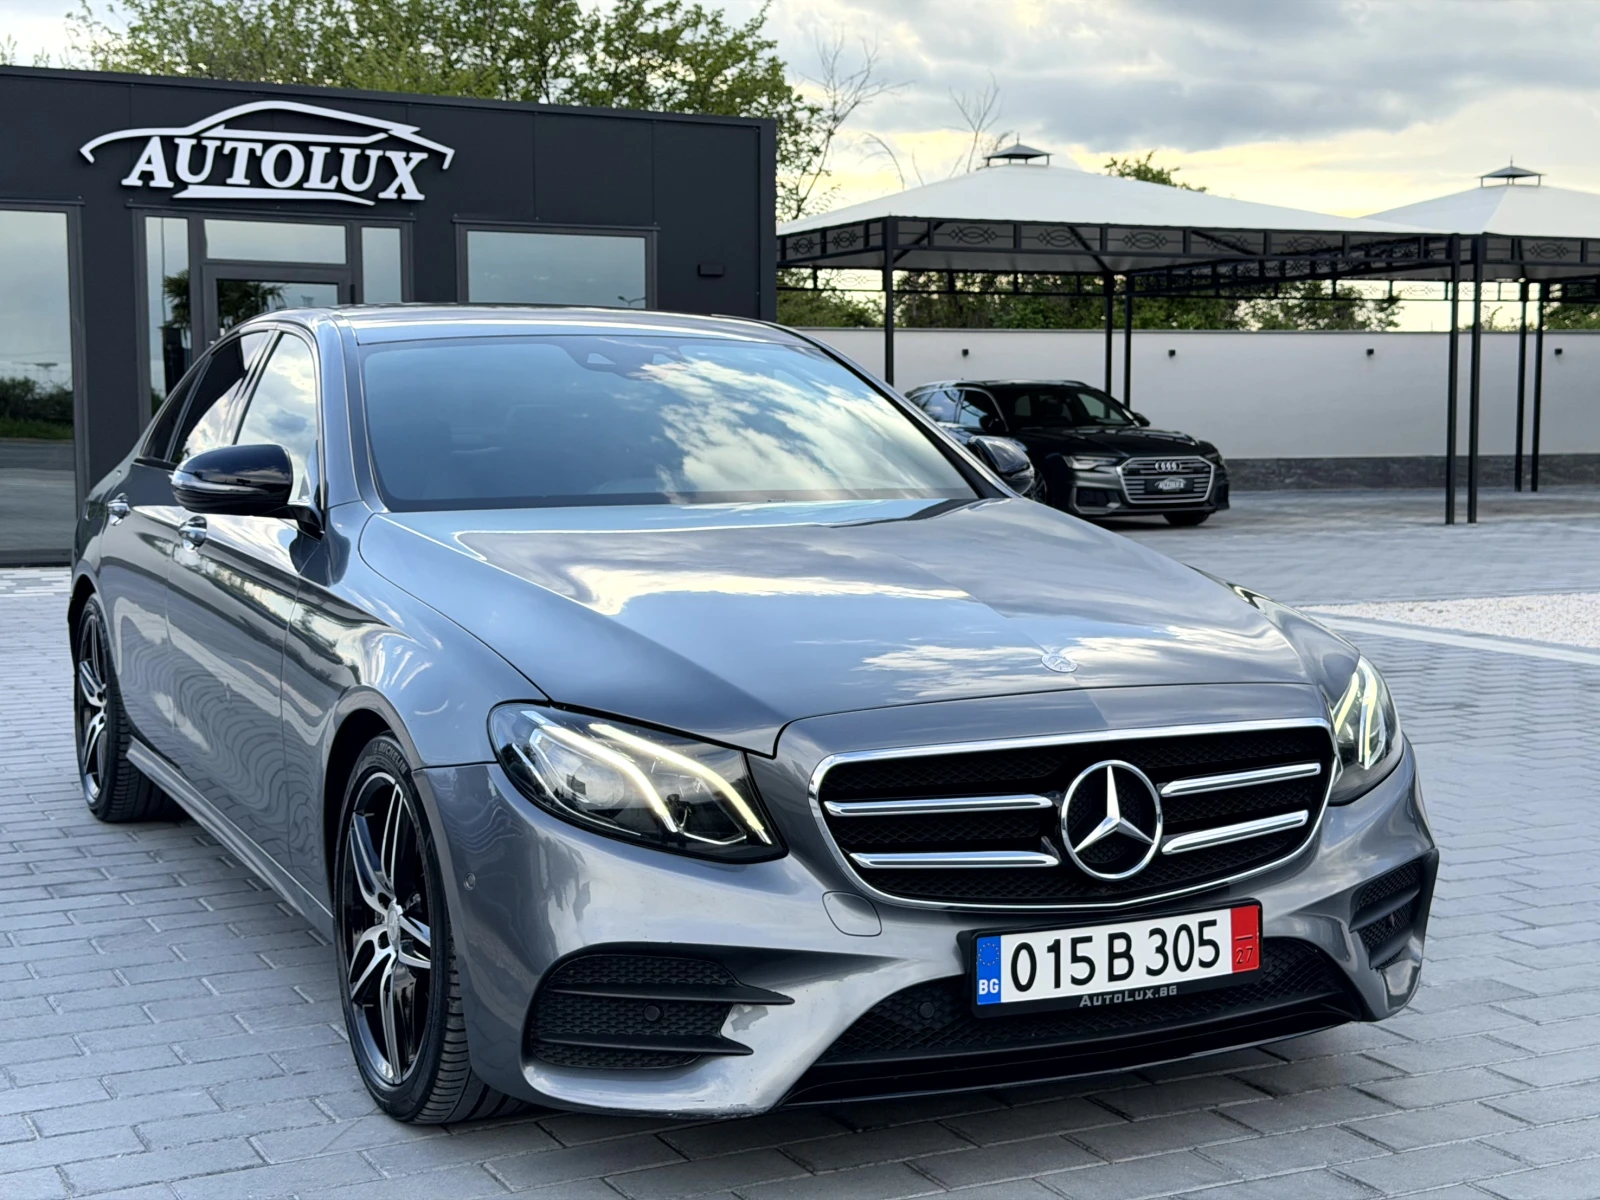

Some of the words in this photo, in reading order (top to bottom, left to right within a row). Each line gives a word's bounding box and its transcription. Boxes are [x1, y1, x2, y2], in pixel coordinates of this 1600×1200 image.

[121, 136, 429, 201] AUTOLUX
[378, 742, 408, 775] MICHELIN
[1010, 935, 1096, 993] 015
[1108, 931, 1135, 983] B
[1145, 919, 1221, 977] 305
[1236, 946, 1254, 965] 27
[978, 978, 999, 996] BG
